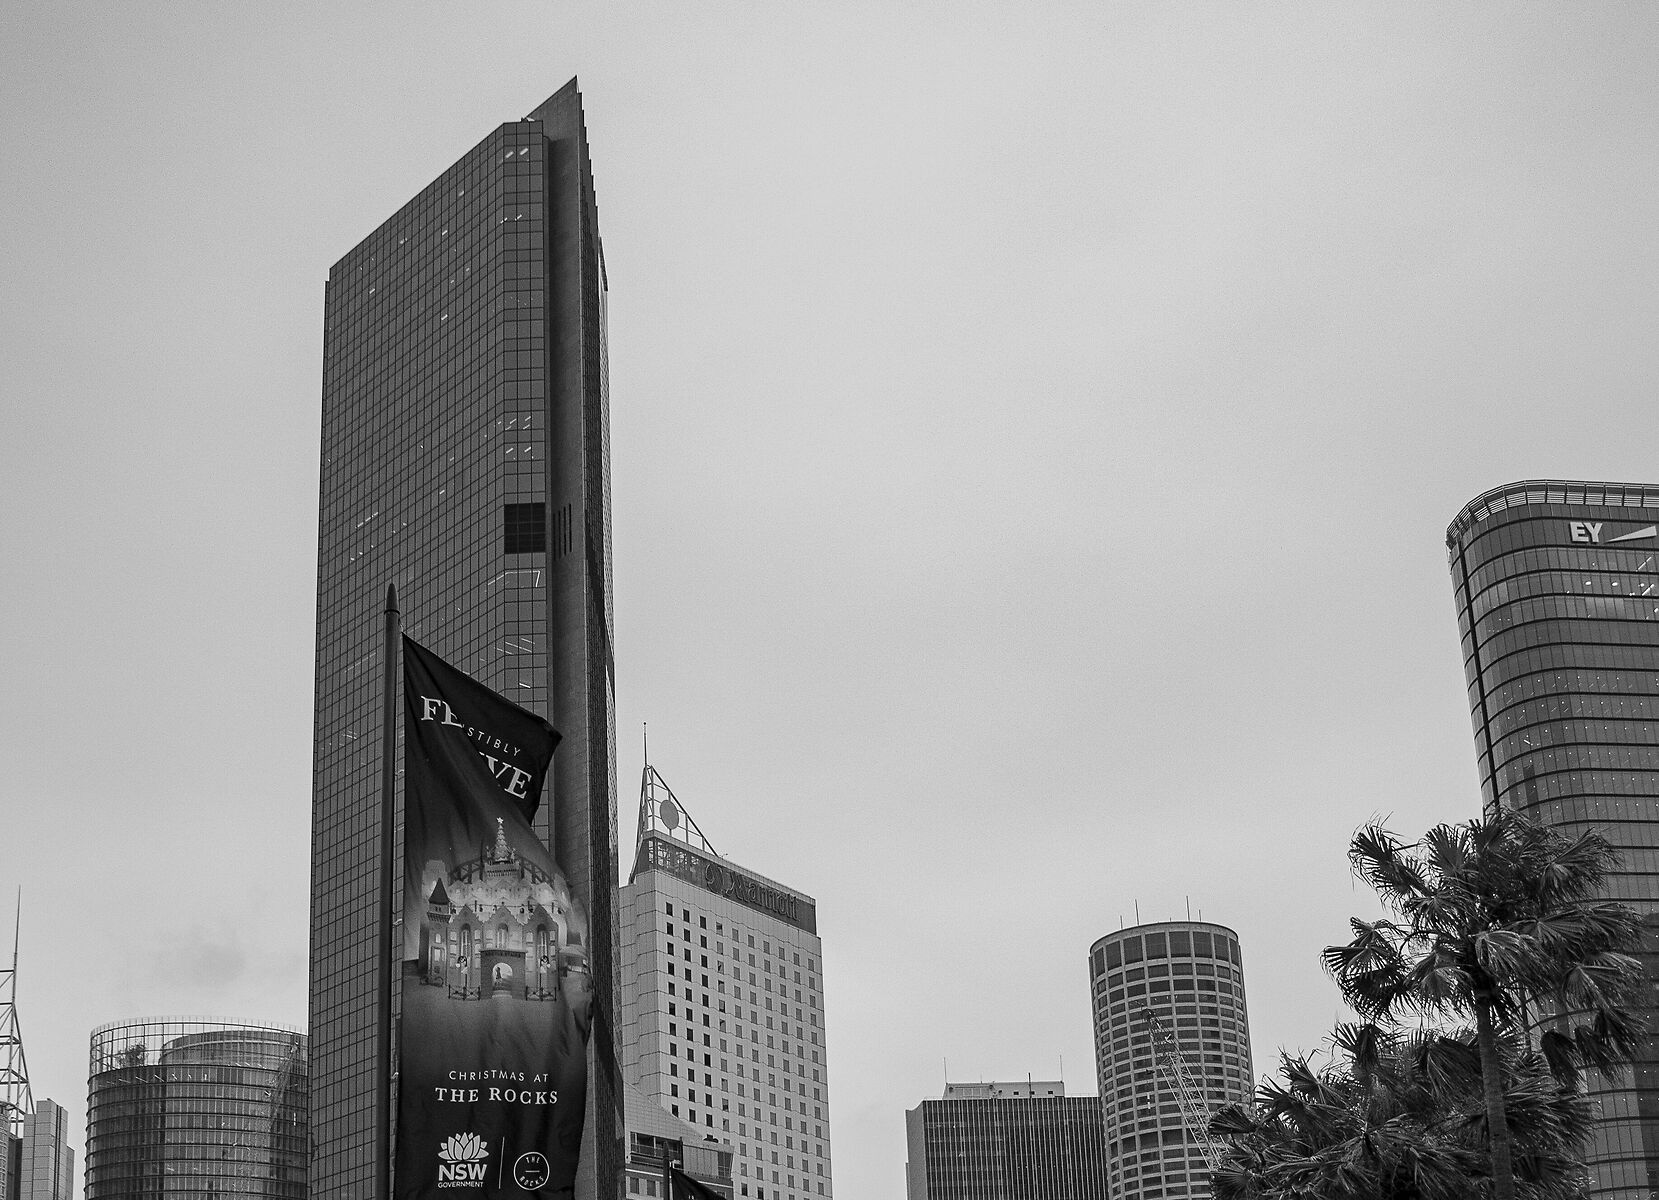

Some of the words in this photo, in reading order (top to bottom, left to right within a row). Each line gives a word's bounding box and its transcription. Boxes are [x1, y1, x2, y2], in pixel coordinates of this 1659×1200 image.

[1569, 521, 1603, 544] EY
[467, 727, 521, 757] STIBLY
[725, 871, 800, 922] Marriott
[448, 1069, 525, 1082] CHRISTMAS
[533, 1073, 549, 1083] AT
[435, 1087, 479, 1103] THE
[488, 1087, 558, 1105] ROCKS
[525, 1156, 541, 1164] THE
[438, 1163, 488, 1181] NSW
[519, 1175, 545, 1187] ROCKS
[437, 1181, 484, 1189] GOVERNMENT
